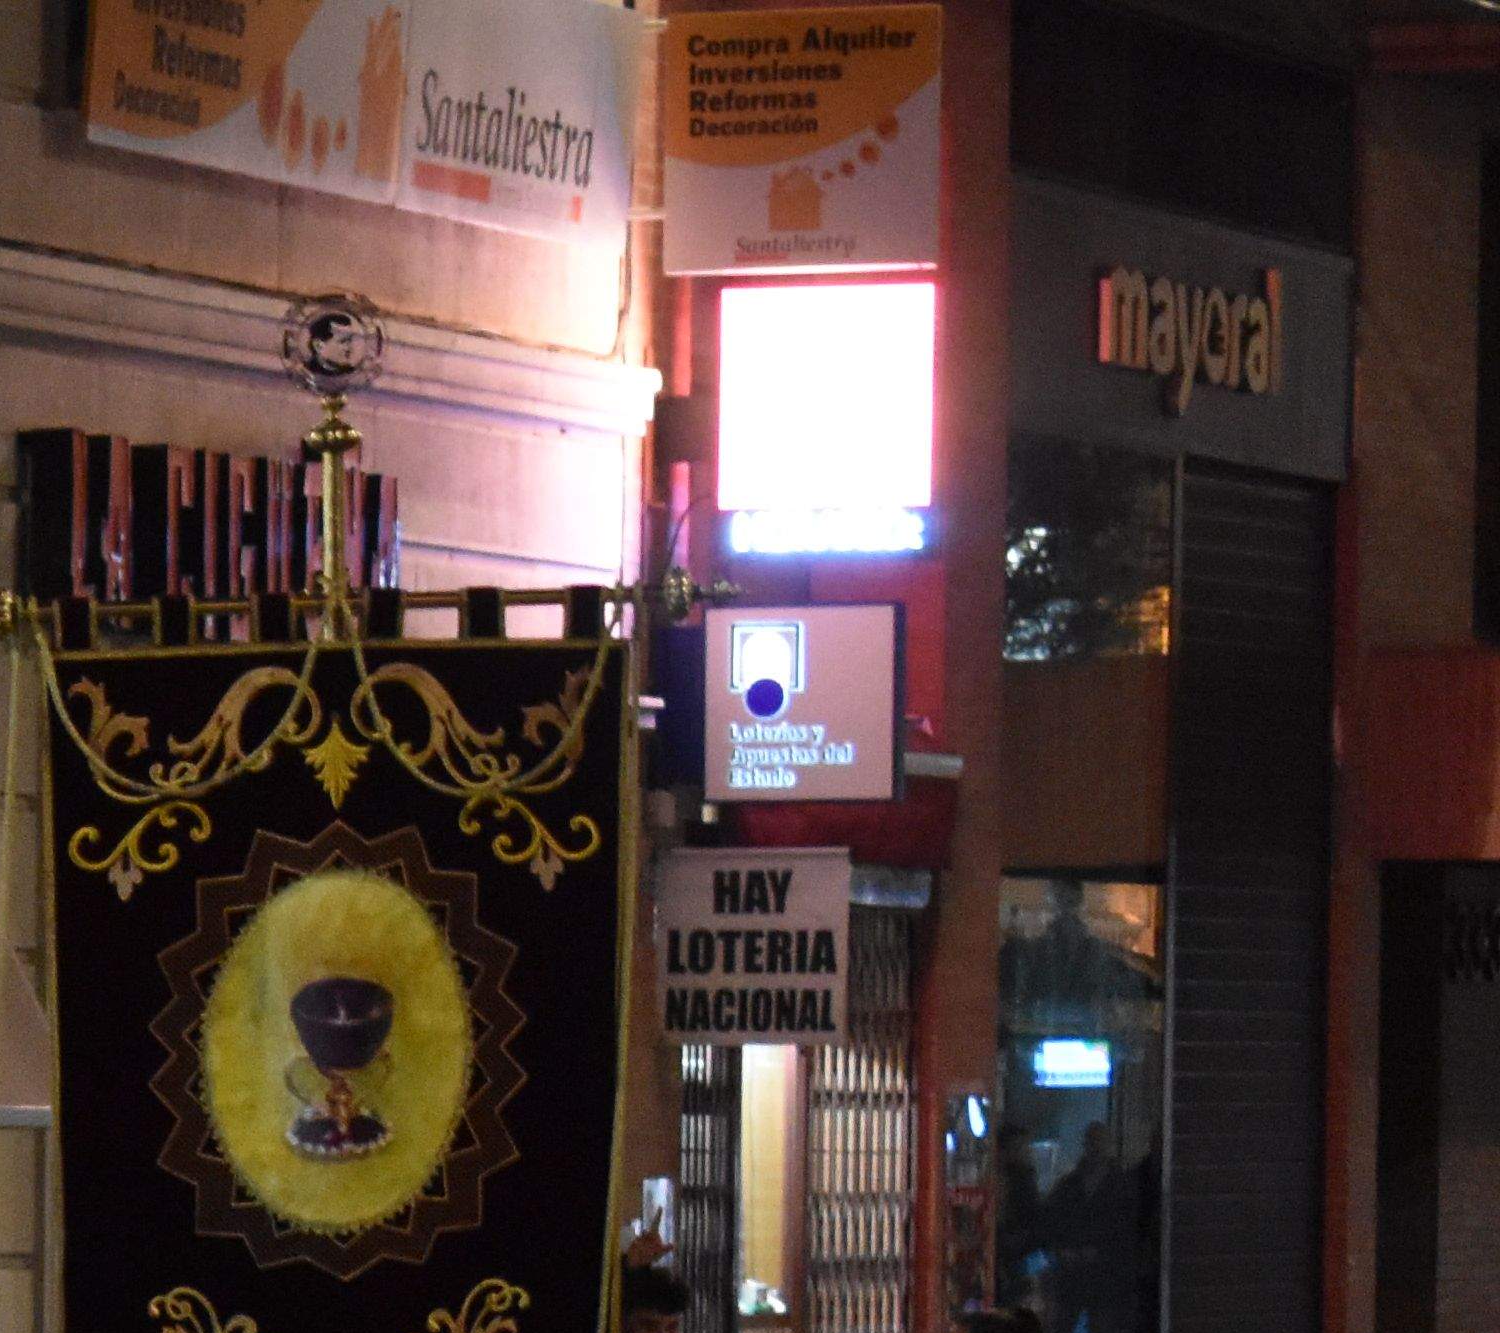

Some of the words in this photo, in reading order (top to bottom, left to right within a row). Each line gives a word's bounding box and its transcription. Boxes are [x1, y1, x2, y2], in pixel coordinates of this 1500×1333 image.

[152, 25, 243, 91] Reformas
[687, 34, 790, 58] Compra
[802, 26, 917, 55] Alquiler
[688, 59, 844, 85] Inversiones
[688, 88, 818, 113] Reformas
[416, 68, 594, 188] Santaliestra
[1098, 265, 1284, 416] mayoral
[712, 868, 793, 915] HAY
[666, 929, 838, 974] LOTERIA
[664, 987, 837, 1033] NACIONAL
